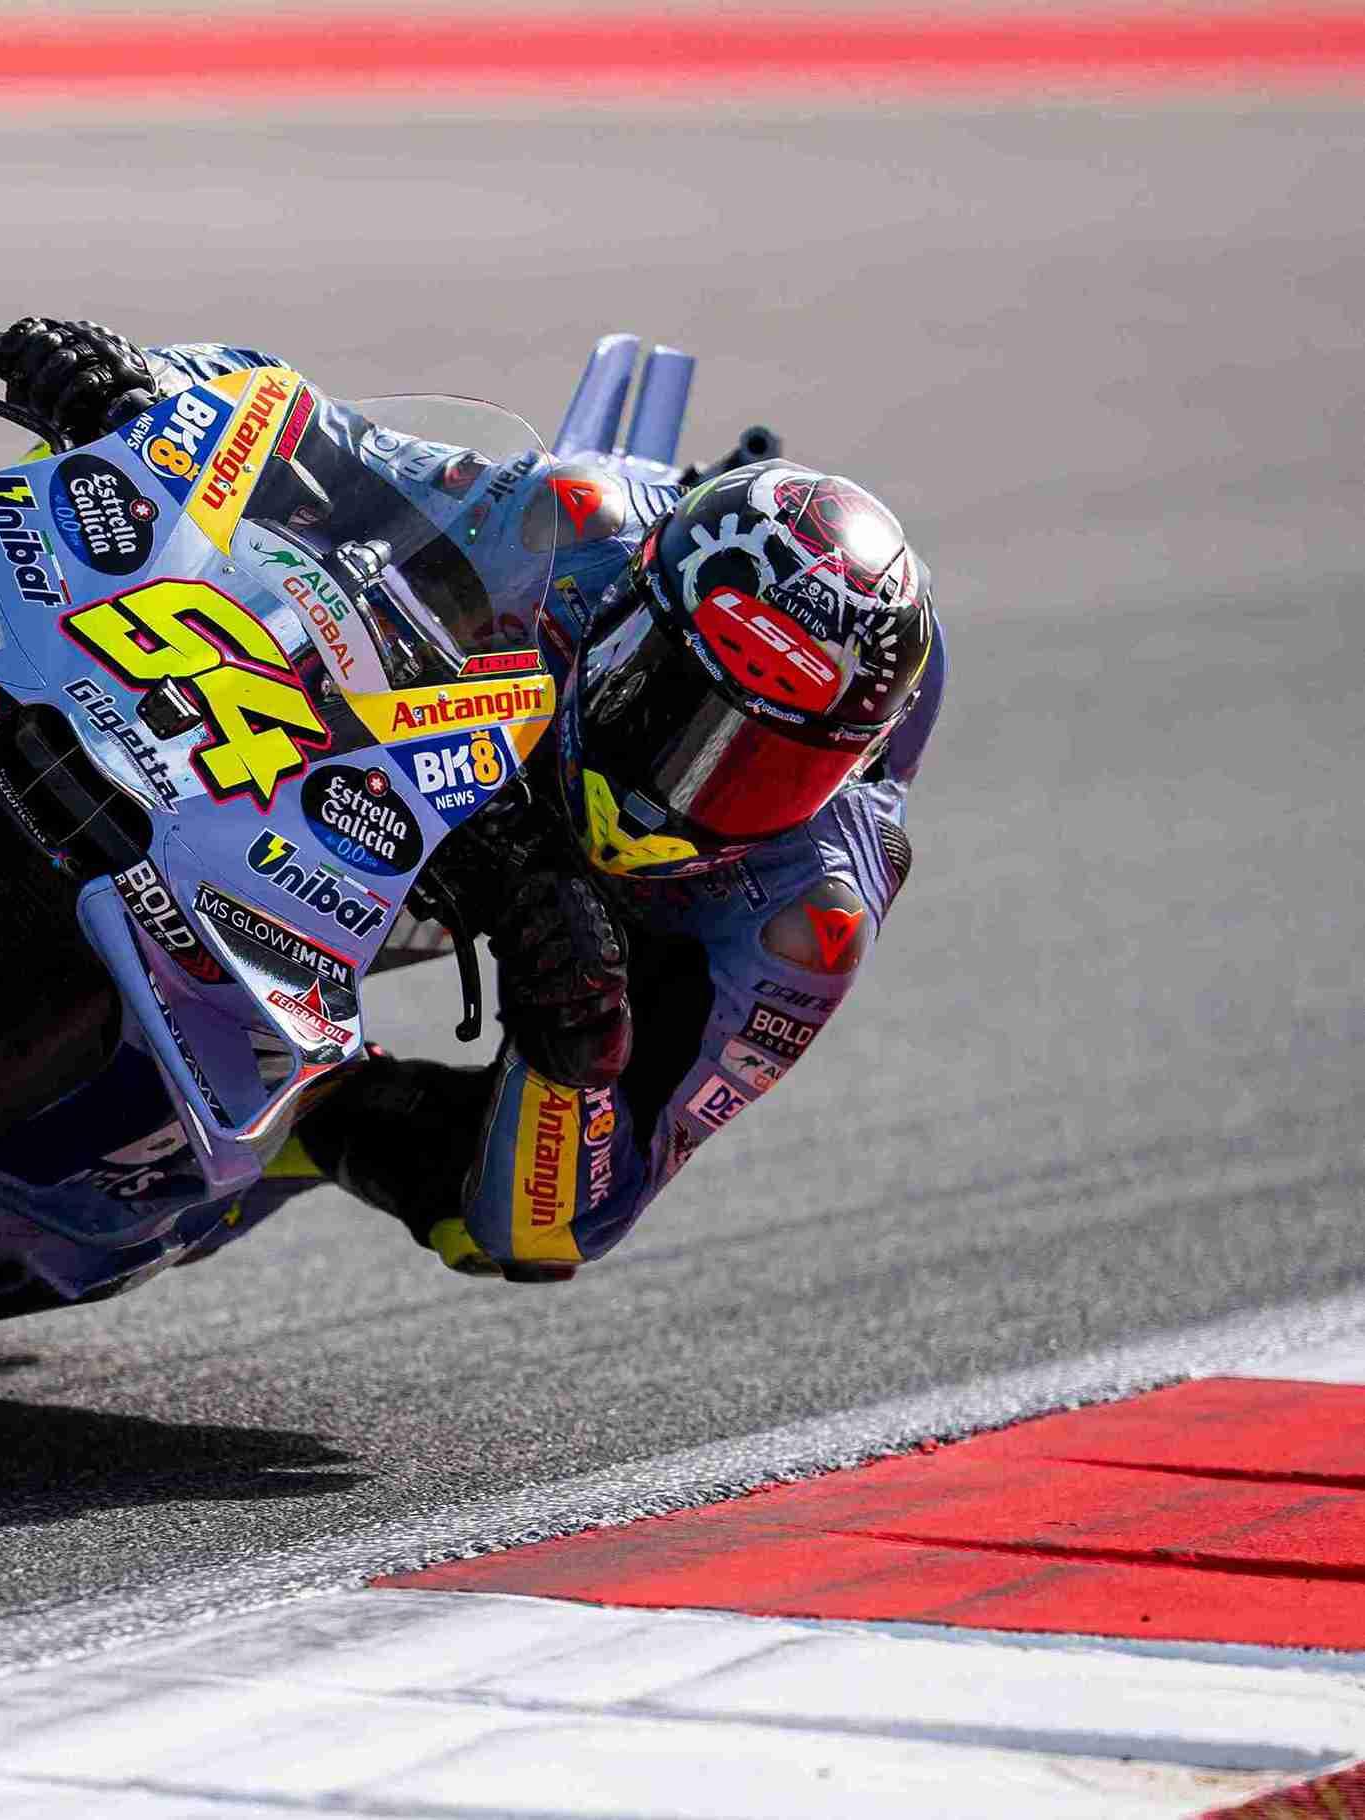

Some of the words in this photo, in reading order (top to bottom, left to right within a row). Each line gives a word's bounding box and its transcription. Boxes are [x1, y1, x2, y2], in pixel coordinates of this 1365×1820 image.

[127, 412, 154, 449] NEWS
[148, 392, 218, 477] BK8
[202, 375, 288, 510] Antangin
[70, 478, 111, 554] Galicia
[91, 473, 137, 554] Estrella
[283, 576, 354, 681] GLOBAL
[300, 571, 351, 622] AUS
[61, 577, 330, 813] 54
[392, 684, 542, 732] Antangin
[63, 677, 179, 804] Gigetta
[413, 738, 501, 794] BK8
[321, 799, 396, 860] Galicia
[324, 776, 407, 840] Estrella
[435, 790, 475, 811] NEWS
[115, 874, 176, 952] RIDERS
[124, 859, 196, 948] BOLD
[246, 827, 387, 939] Unibat
[199, 891, 229, 919] MS
[231, 911, 292, 951] GLOW
[301, 949, 348, 984] MEN
[271, 992, 325, 1029] FEDERAL
[326, 1025, 348, 1042] OIL
[752, 1009, 813, 1045] BOLD
[524, 1084, 573, 1227] Antangin
[585, 1087, 615, 1147] K8
